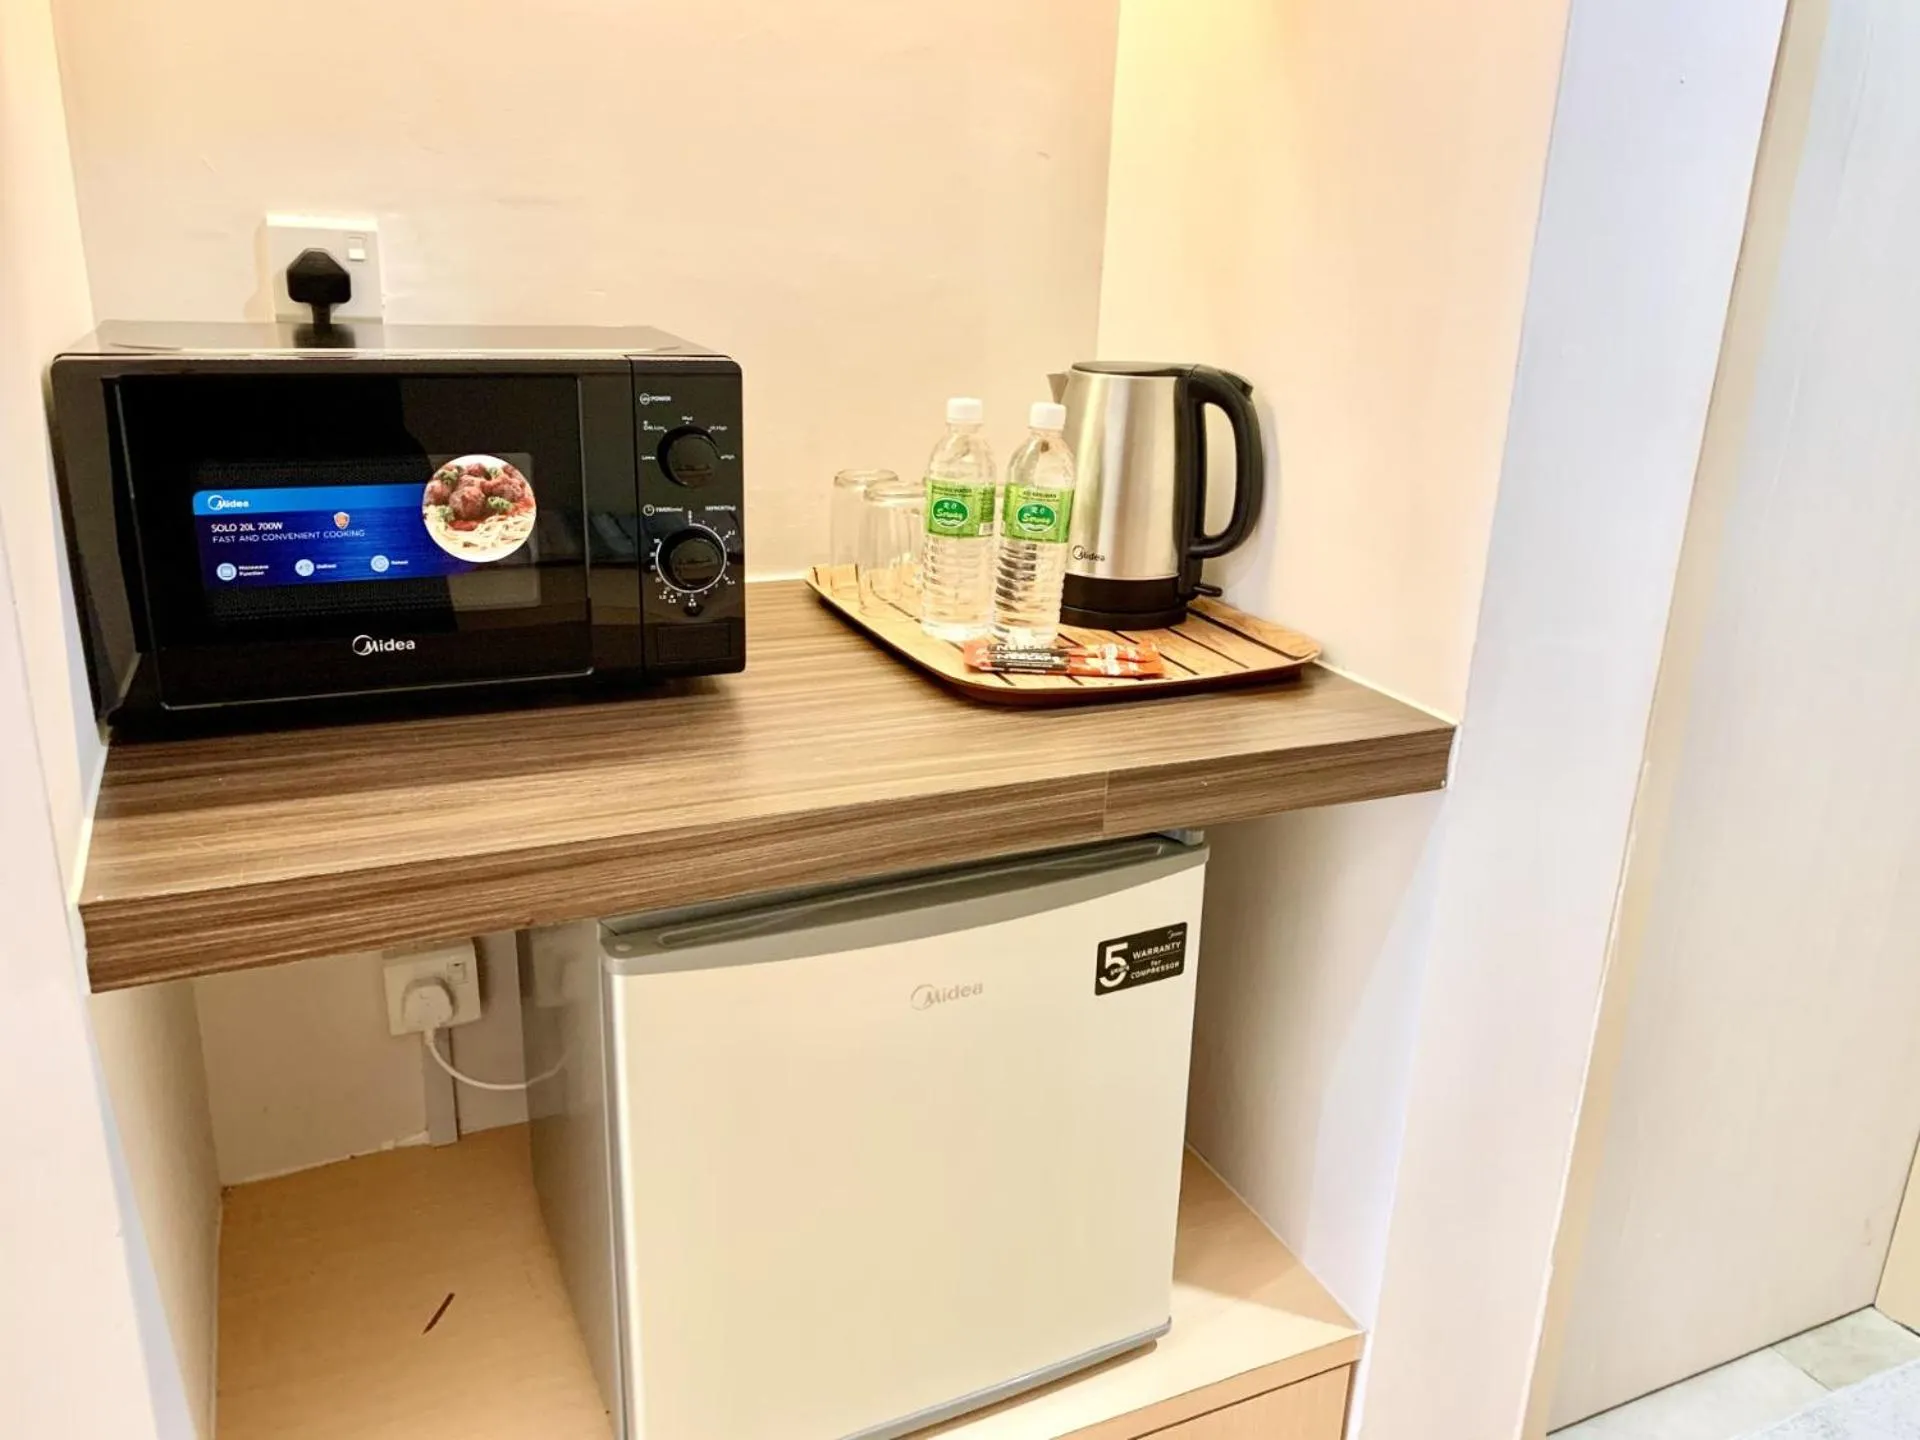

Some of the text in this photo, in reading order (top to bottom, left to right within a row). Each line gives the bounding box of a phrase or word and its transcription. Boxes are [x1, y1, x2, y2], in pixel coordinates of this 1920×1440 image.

[208, 495, 249, 511] Midea
[211, 521, 283, 533] SOLO 20L 700W
[212, 529, 365, 543] FAST AND CONVENIENT COOKING
[1072, 544, 1106, 562] Midea
[352, 634, 416, 656] Midea
[1132, 940, 1182, 961] WARRANTY
[1099, 942, 1129, 988] 5
[1130, 961, 1180, 980] COMPRESSOR
[910, 983, 984, 1012] Midea
